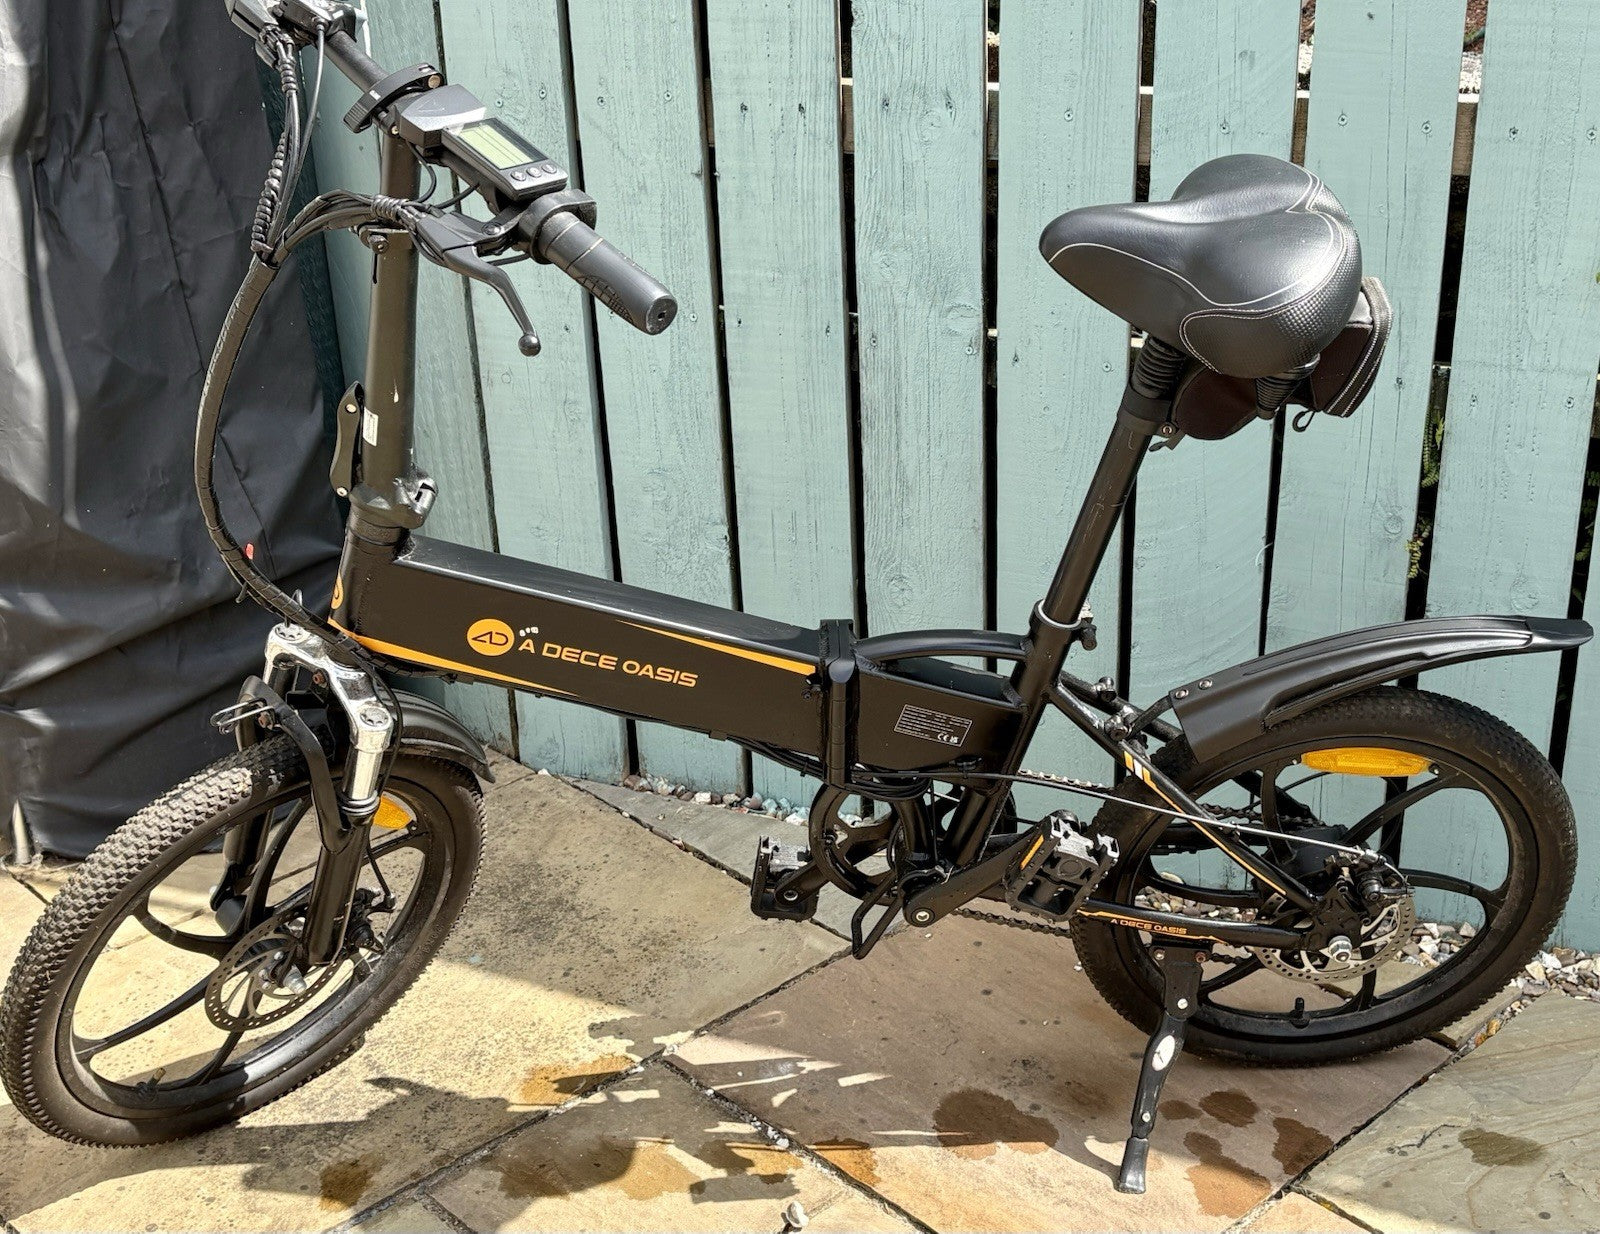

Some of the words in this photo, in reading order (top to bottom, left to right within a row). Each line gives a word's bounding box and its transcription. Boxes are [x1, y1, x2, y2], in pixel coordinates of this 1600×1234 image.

[518, 638, 535, 654] A
[542, 643, 618, 670] DECE
[622, 660, 698, 688] OASIS
[1153, 925, 1187, 935] OASIS
